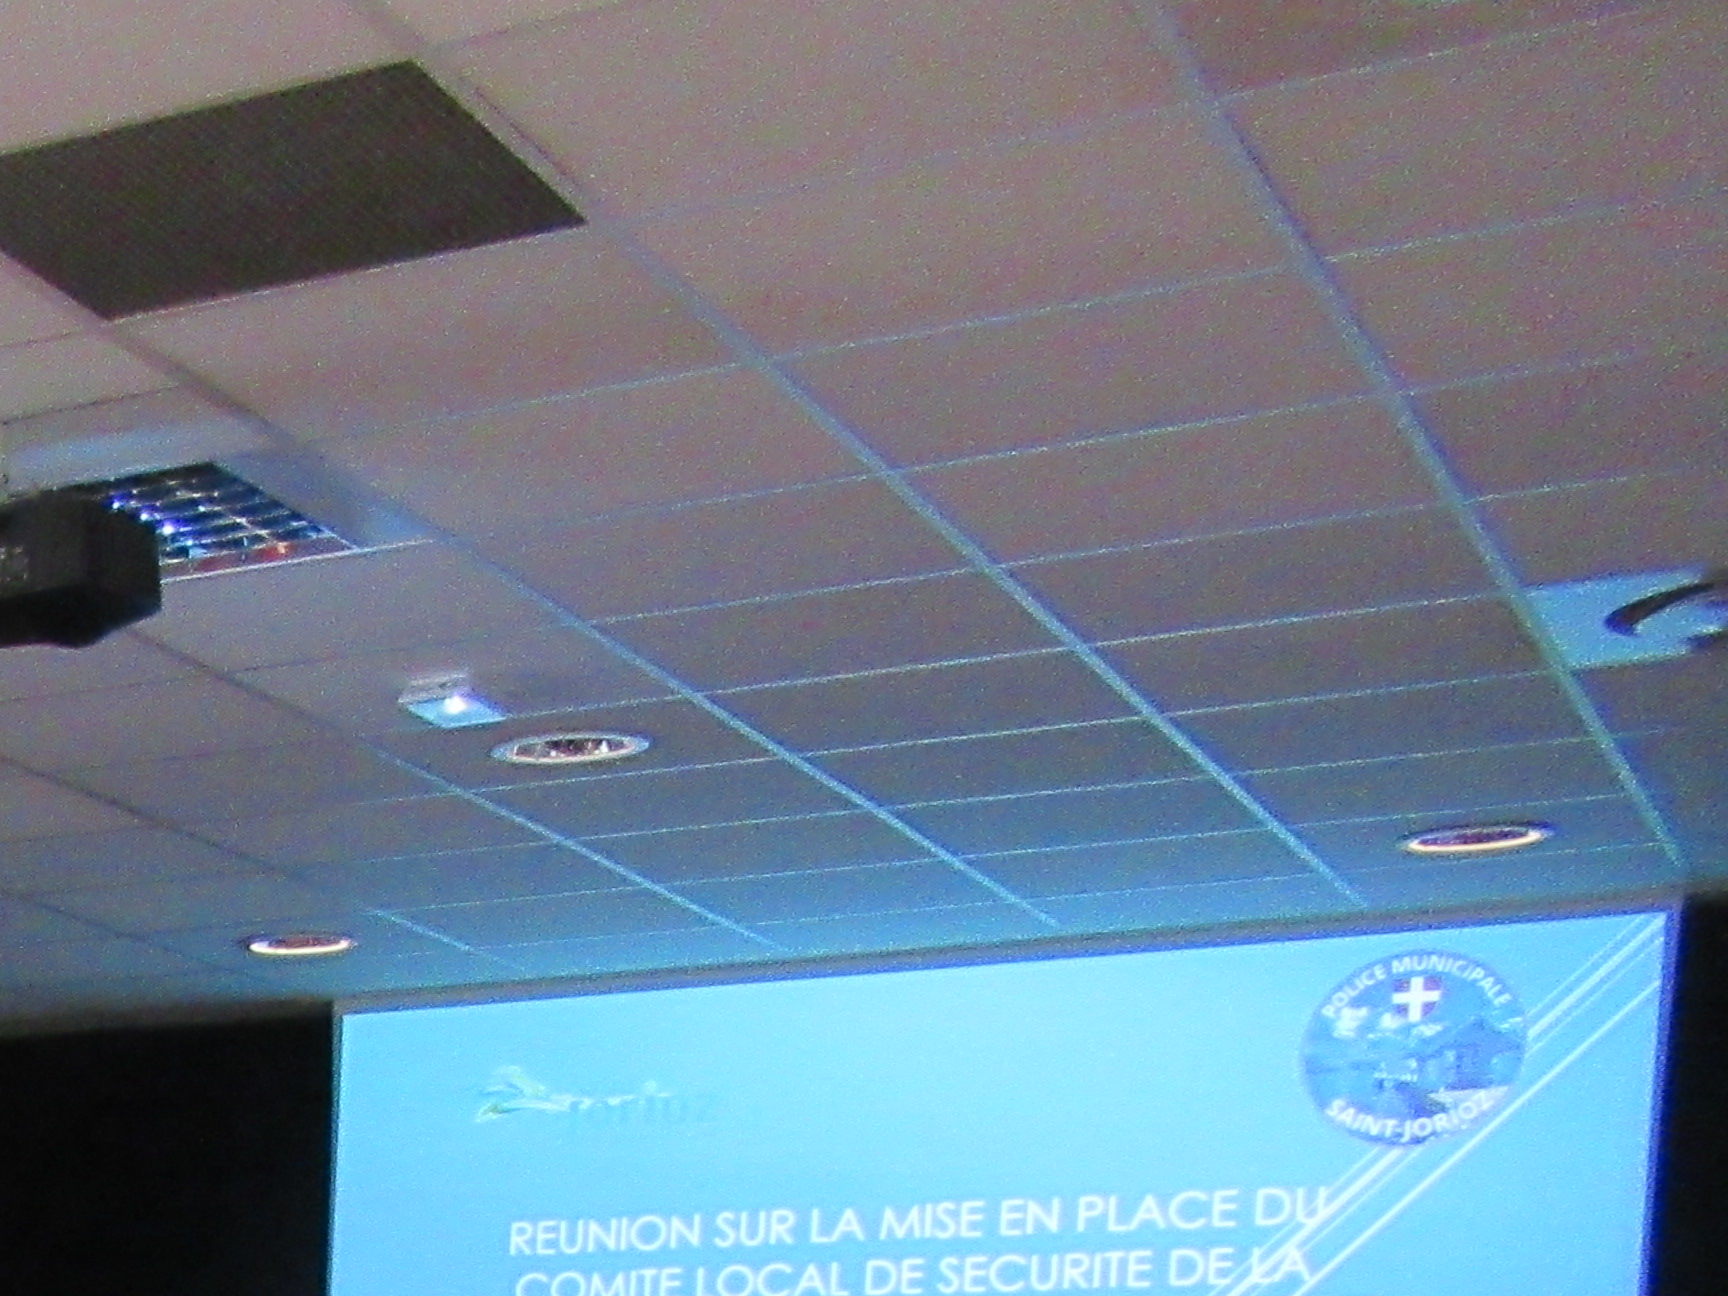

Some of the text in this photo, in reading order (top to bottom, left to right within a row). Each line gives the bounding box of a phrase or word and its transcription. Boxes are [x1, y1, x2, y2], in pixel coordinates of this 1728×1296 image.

[1321, 954, 1513, 1018] POLICE MUNICIPALE
[1325, 1093, 1493, 1143] SAINT-JORIOZ
[509, 1186, 1328, 1256] REUNION SUR LA MISE EN PLACE DU
[938, 1250, 1152, 1295] SECURITE
[1168, 1246, 1234, 1286] DE
[1248, 1243, 1310, 1284] LA
